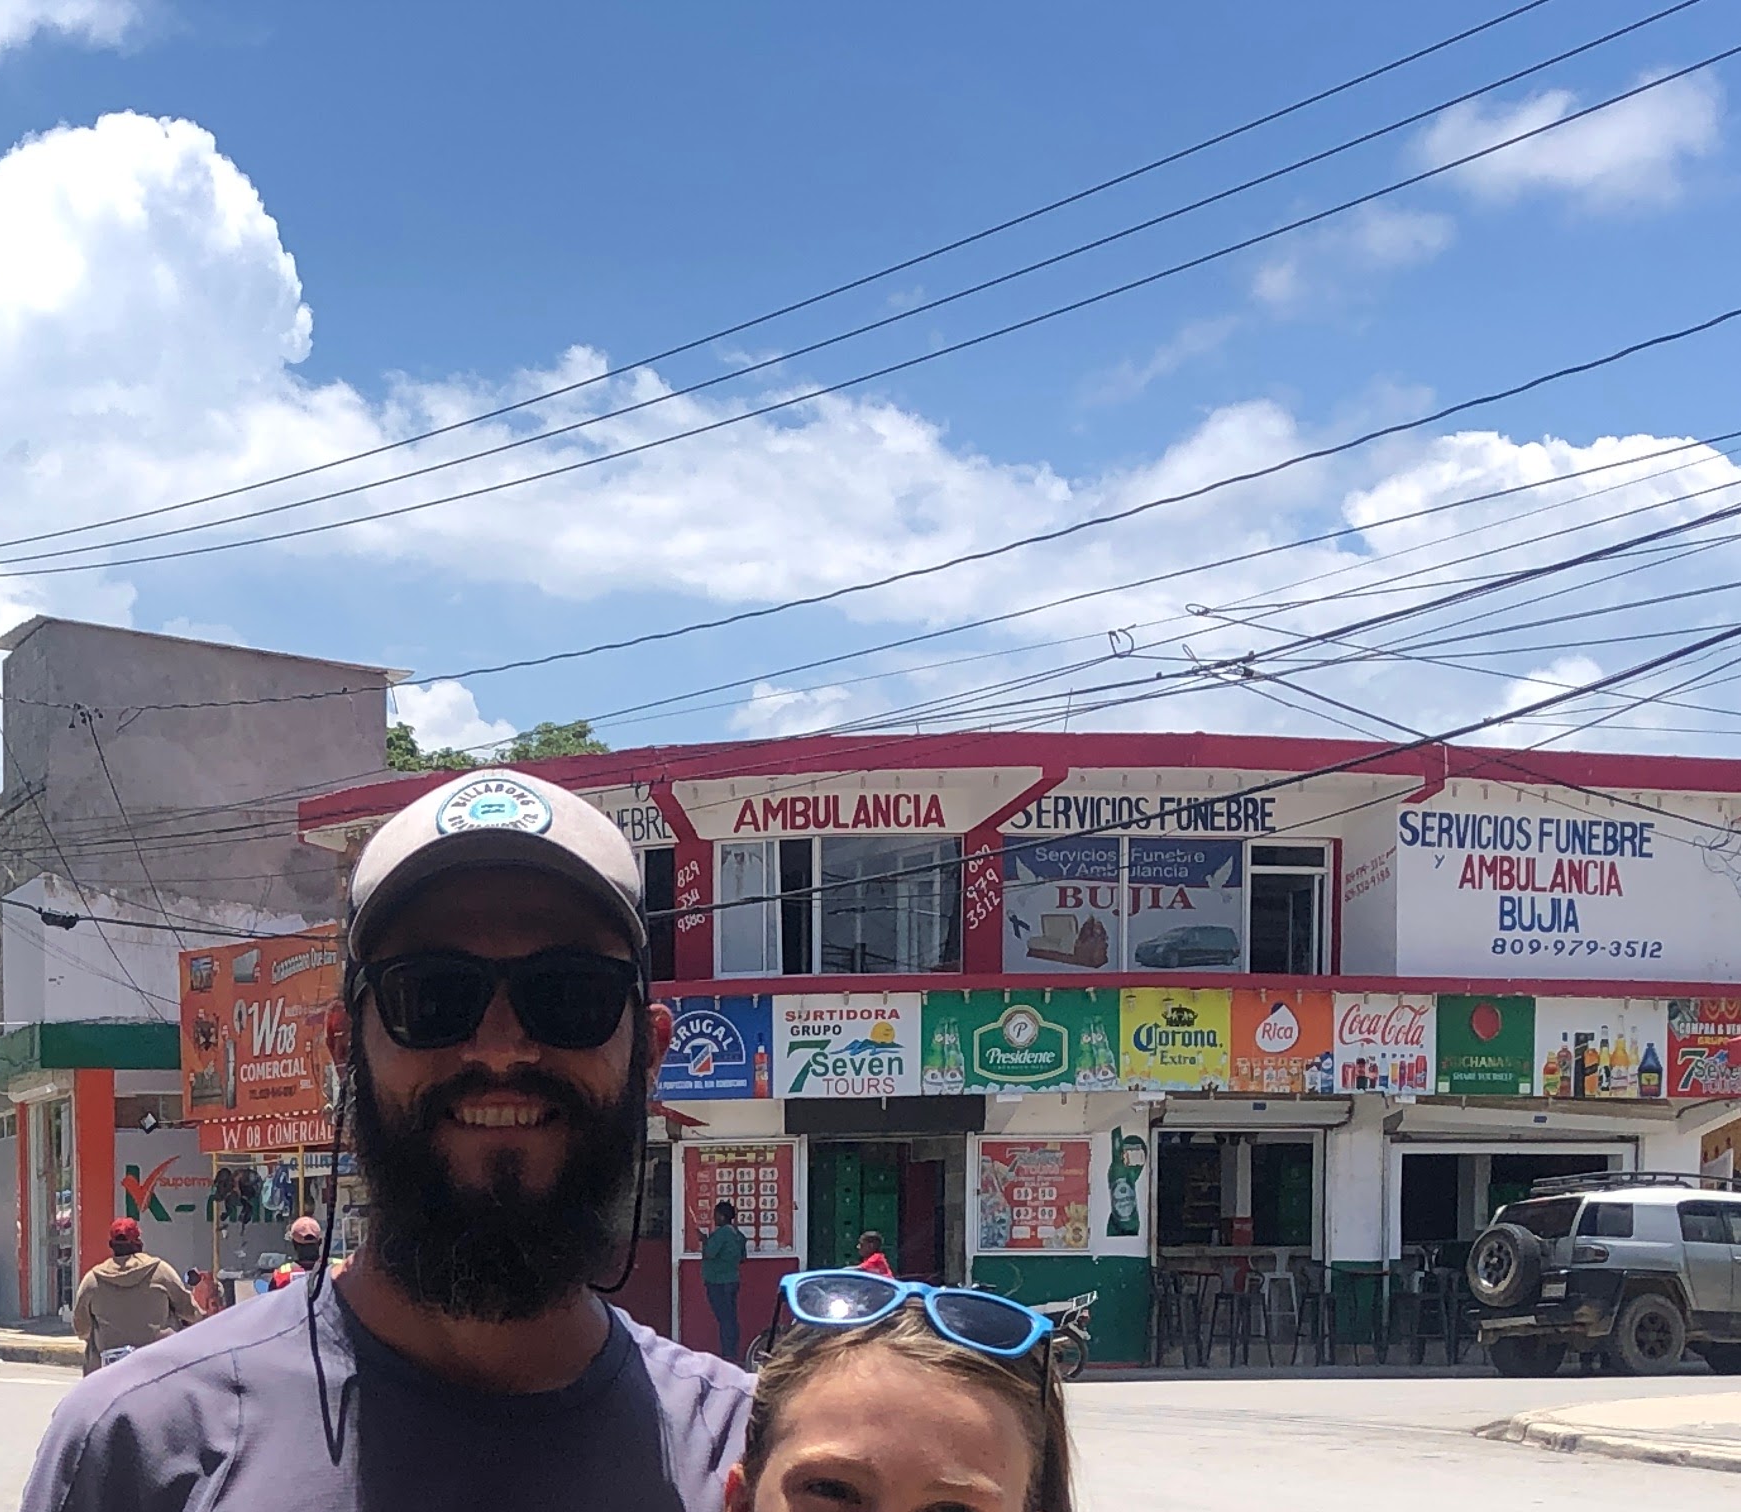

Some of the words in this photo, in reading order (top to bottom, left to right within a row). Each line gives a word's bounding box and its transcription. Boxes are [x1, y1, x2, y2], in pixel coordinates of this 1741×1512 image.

[450, 783, 536, 808] BILLABONG
[733, 793, 946, 833] AMBULANCIA
[1010, 795, 1151, 830] SERVICIOS
[1159, 797, 1277, 832] FUNEBRE
[1399, 810, 1532, 852] SERVICIOS
[1538, 818, 1655, 859] FUNEBRE
[1035, 847, 1117, 863] Servicios
[1130, 848, 1206, 863] Funebre
[1059, 864, 1069, 877] Y
[1075, 863, 1190, 878] Ambulancia
[677, 860, 701, 888] 829
[966, 868, 999, 902] 979
[1458, 854, 1624, 897] AMBULANCIA
[966, 890, 1001, 930] 3512
[1055, 886, 1197, 917] BUJIA
[1498, 895, 1580, 933] BUJIA
[785, 1008, 900, 1023] SURTIDORA
[790, 1024, 842, 1037] GRUPO
[1339, 1003, 1430, 1047] Coca-Cola
[1679, 1022, 1716, 1035] COMPRA
[669, 1018, 734, 1052] BRUGAL
[1261, 1022, 1294, 1042] Rica
[240, 1056, 307, 1083] COMERCIAL
[786, 1039, 832, 1094] 7
[810, 1051, 905, 1078] Seven
[985, 1047, 1056, 1065] Presidente
[1160, 1052, 1197, 1066] Extra
[1677, 1048, 1709, 1092] 7
[822, 1077, 896, 1095] TOURS
[222, 1123, 243, 1151] W
[247, 1125, 261, 1148] 08
[267, 1117, 335, 1147] COMERCIAL
